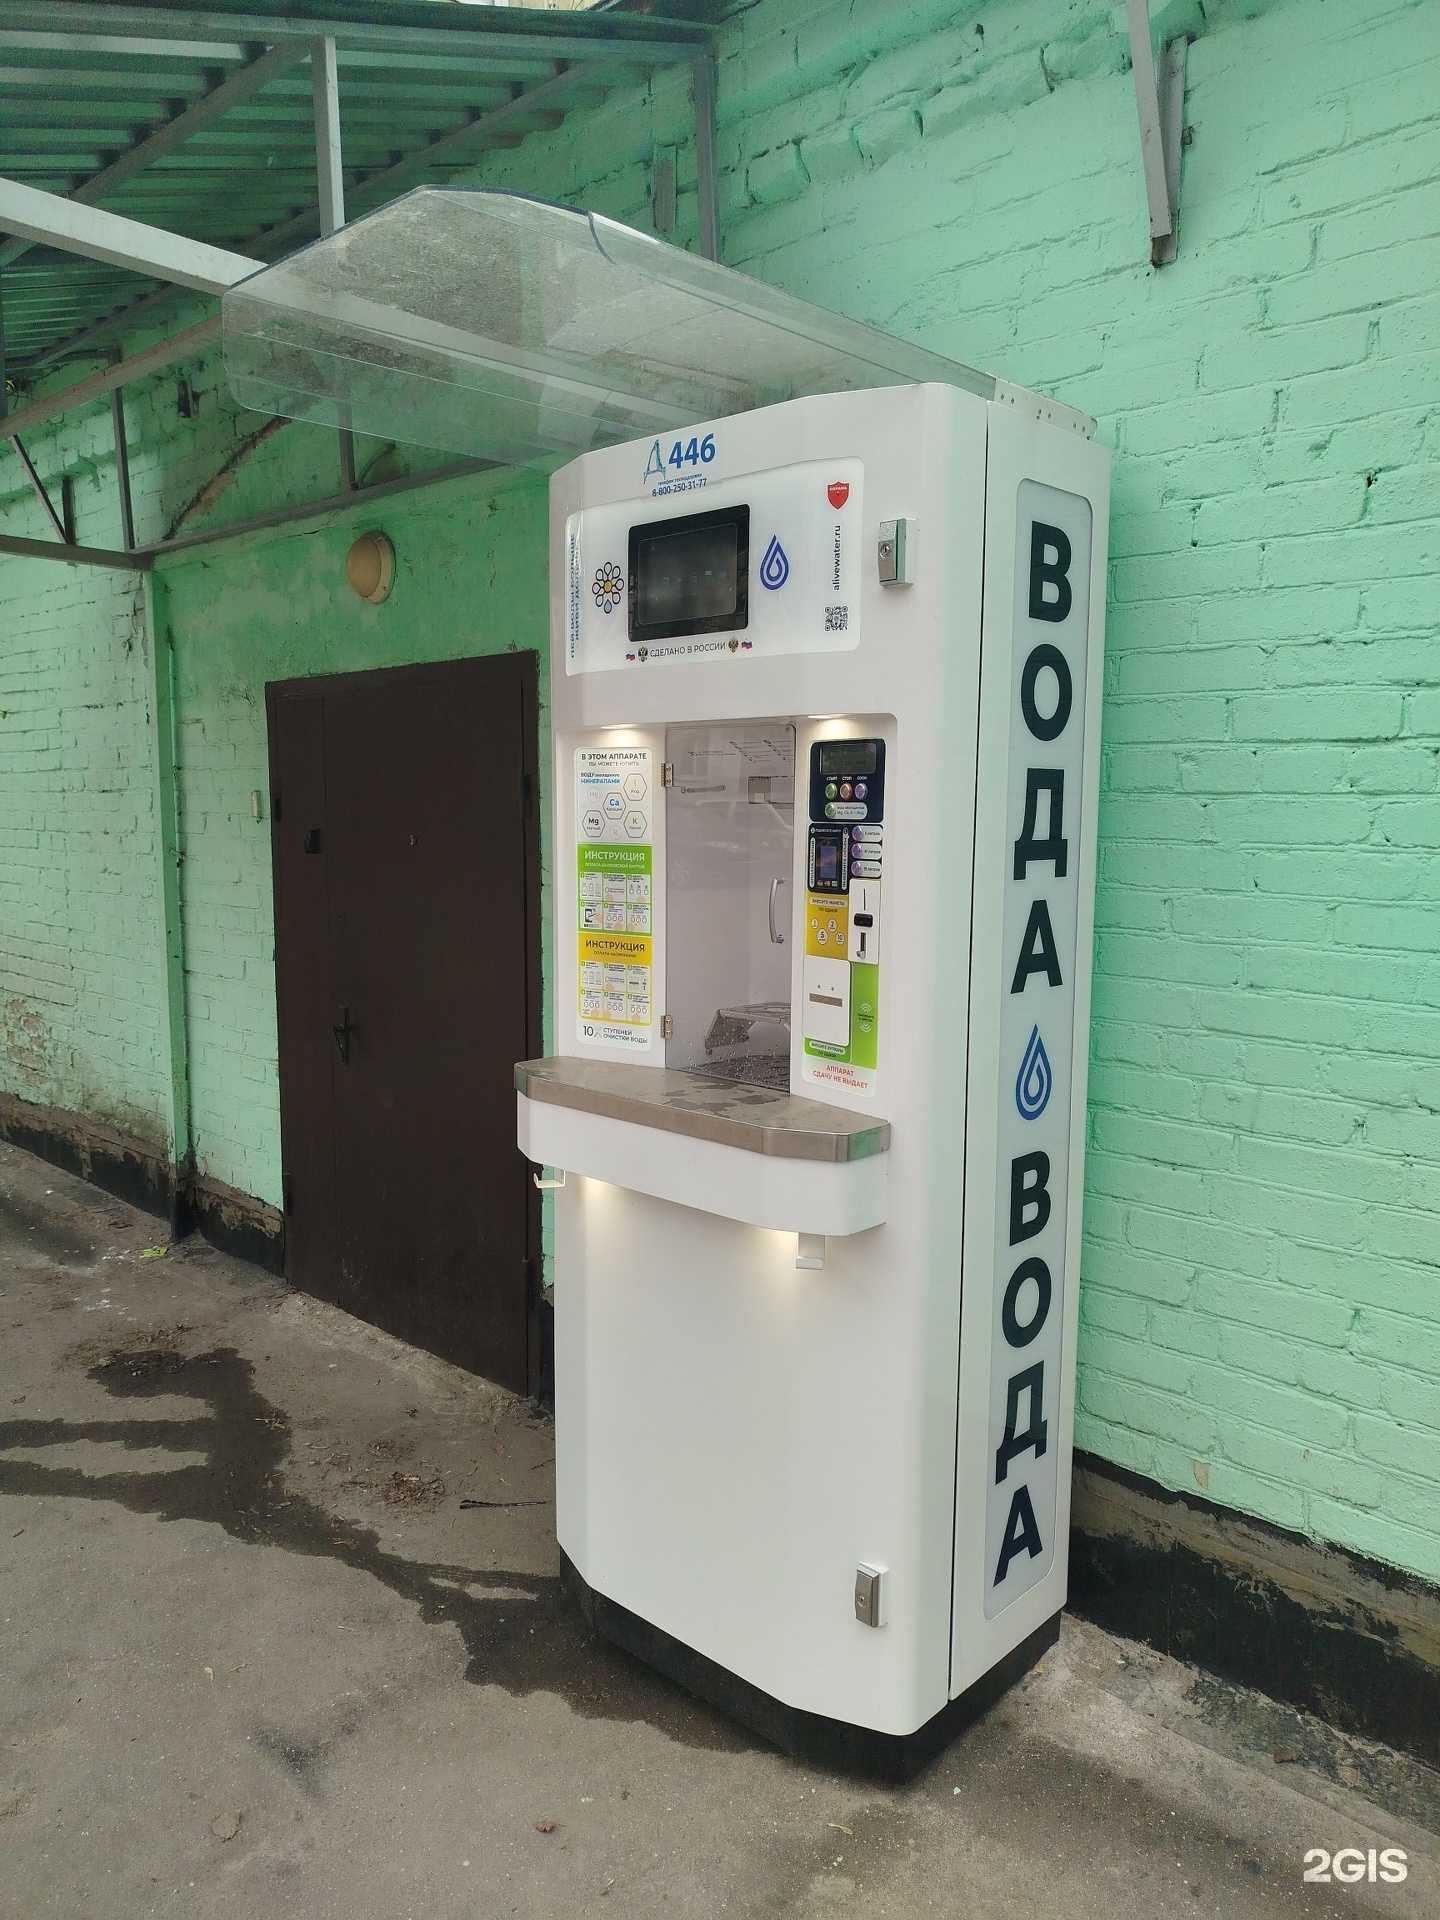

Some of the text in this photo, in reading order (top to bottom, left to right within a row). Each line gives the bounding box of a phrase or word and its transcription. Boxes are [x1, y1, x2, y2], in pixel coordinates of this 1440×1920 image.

[668, 433, 715, 468] 446
[652, 478, 707, 497] 8-800-250-31-77
[832, 525, 841, 591] alivewater.ru
[650, 642, 726, 657] СДЕЛАНО В РОССИИ
[609, 752, 647, 760] АППАРАТЕ
[1009, 520, 1073, 995] ВОДА
[609, 798, 620, 806] Ca
[588, 817, 599, 826] Mg
[585, 850, 645, 862] ИНСТРУКЦИЯ
[586, 940, 645, 952] ИНСТРУКЦИЯ
[583, 1025, 594, 1037] 10
[826, 1064, 854, 1076] АППАРАТ
[813, 1070, 833, 1080] СДАЧУ
[833, 1074, 841, 1083] НЕ
[993, 1150, 1052, 1589] ВОДА
